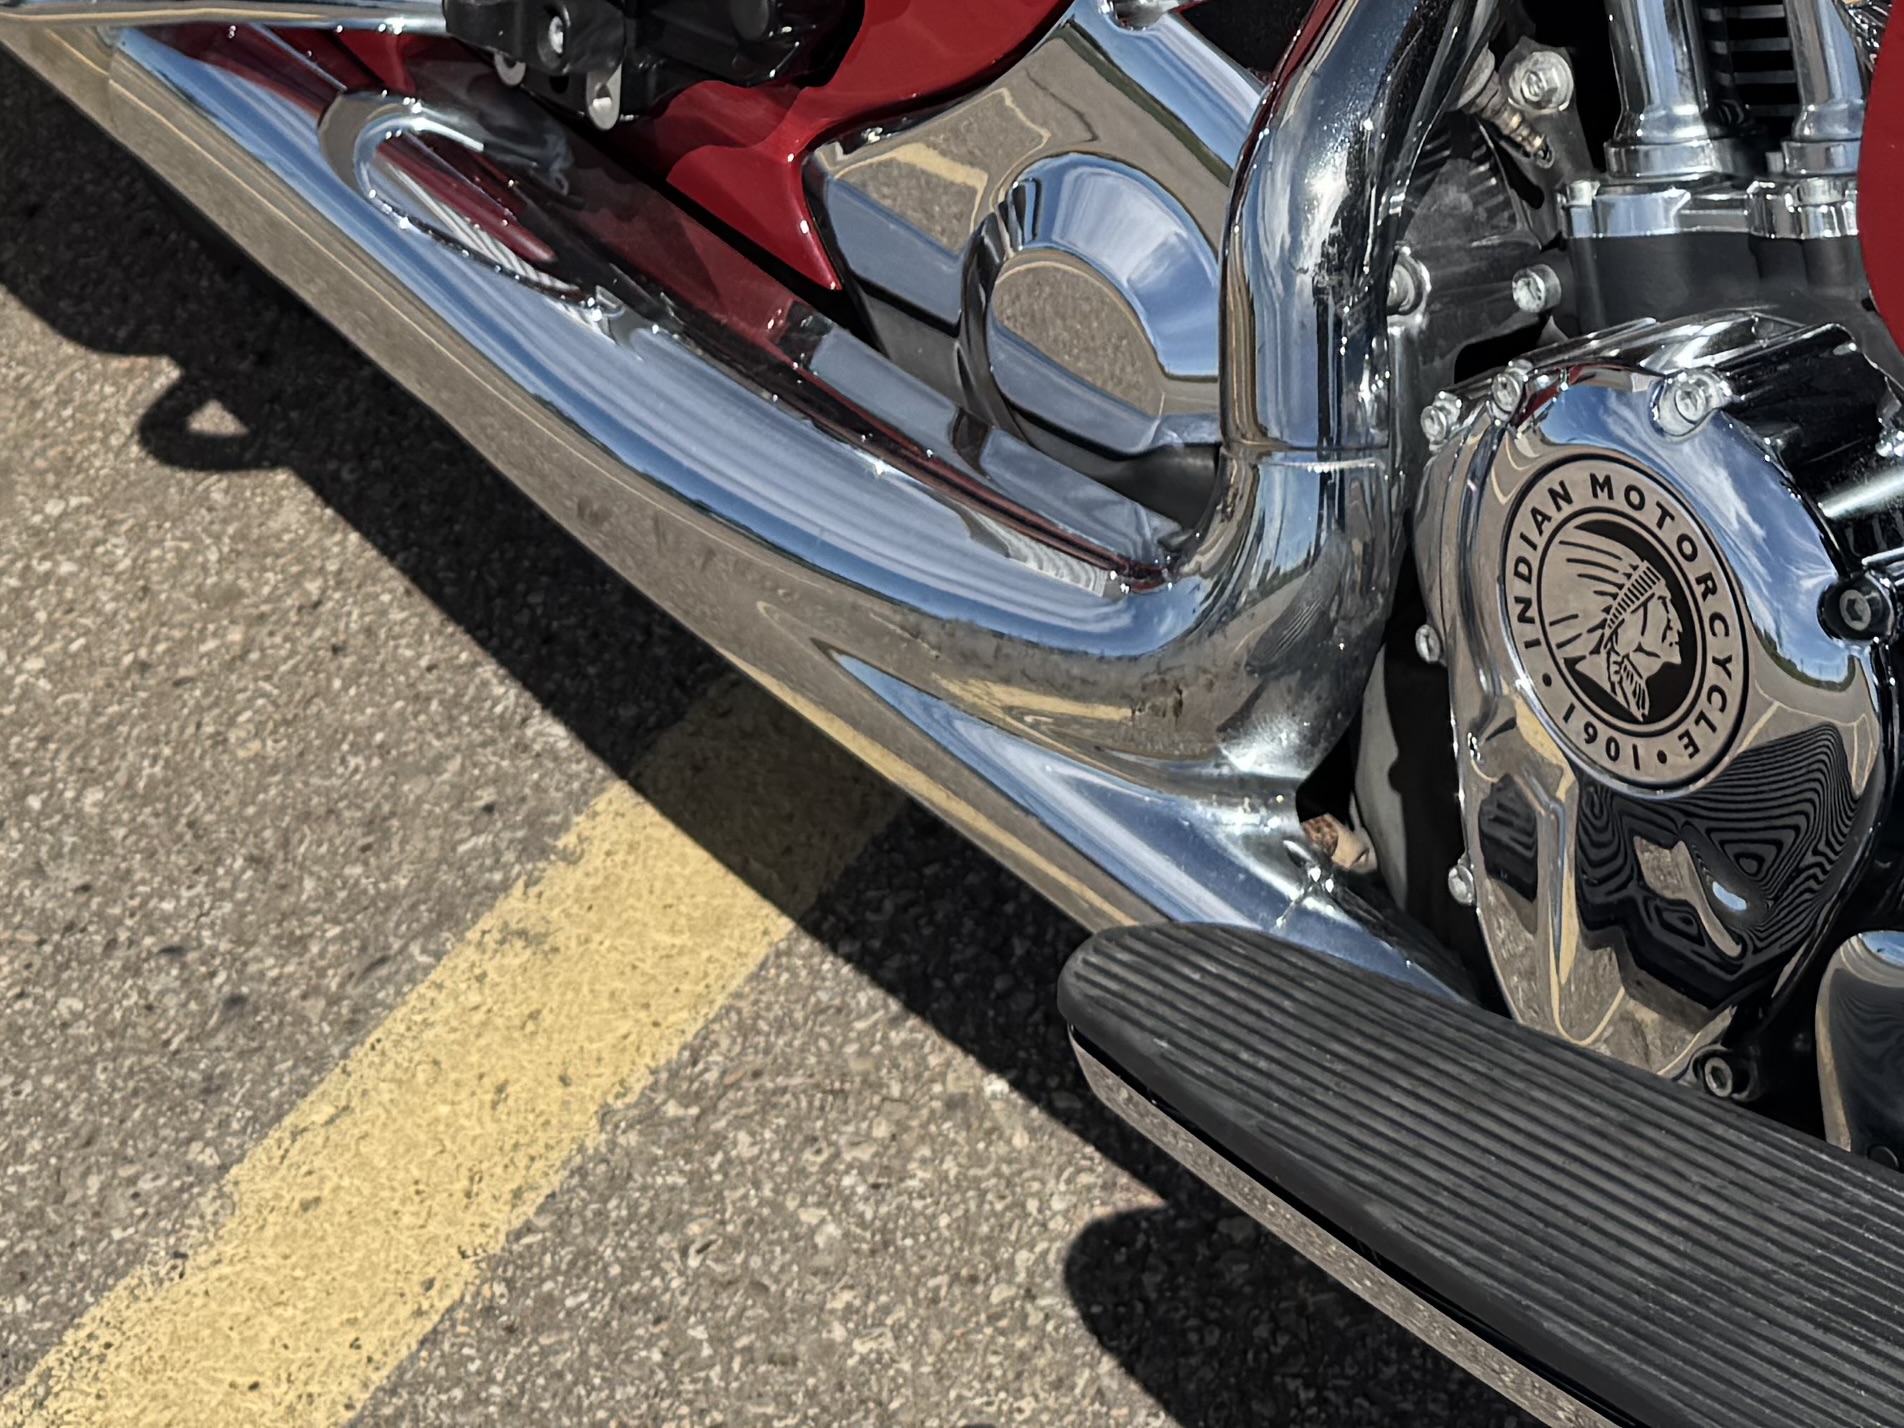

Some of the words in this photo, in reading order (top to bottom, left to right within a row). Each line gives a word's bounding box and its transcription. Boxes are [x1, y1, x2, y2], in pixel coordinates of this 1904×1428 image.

[1513, 480, 1573, 650] INDIAN
[1589, 472, 1733, 759] MOTORCYCLE
[1560, 702, 1641, 771] 1901
